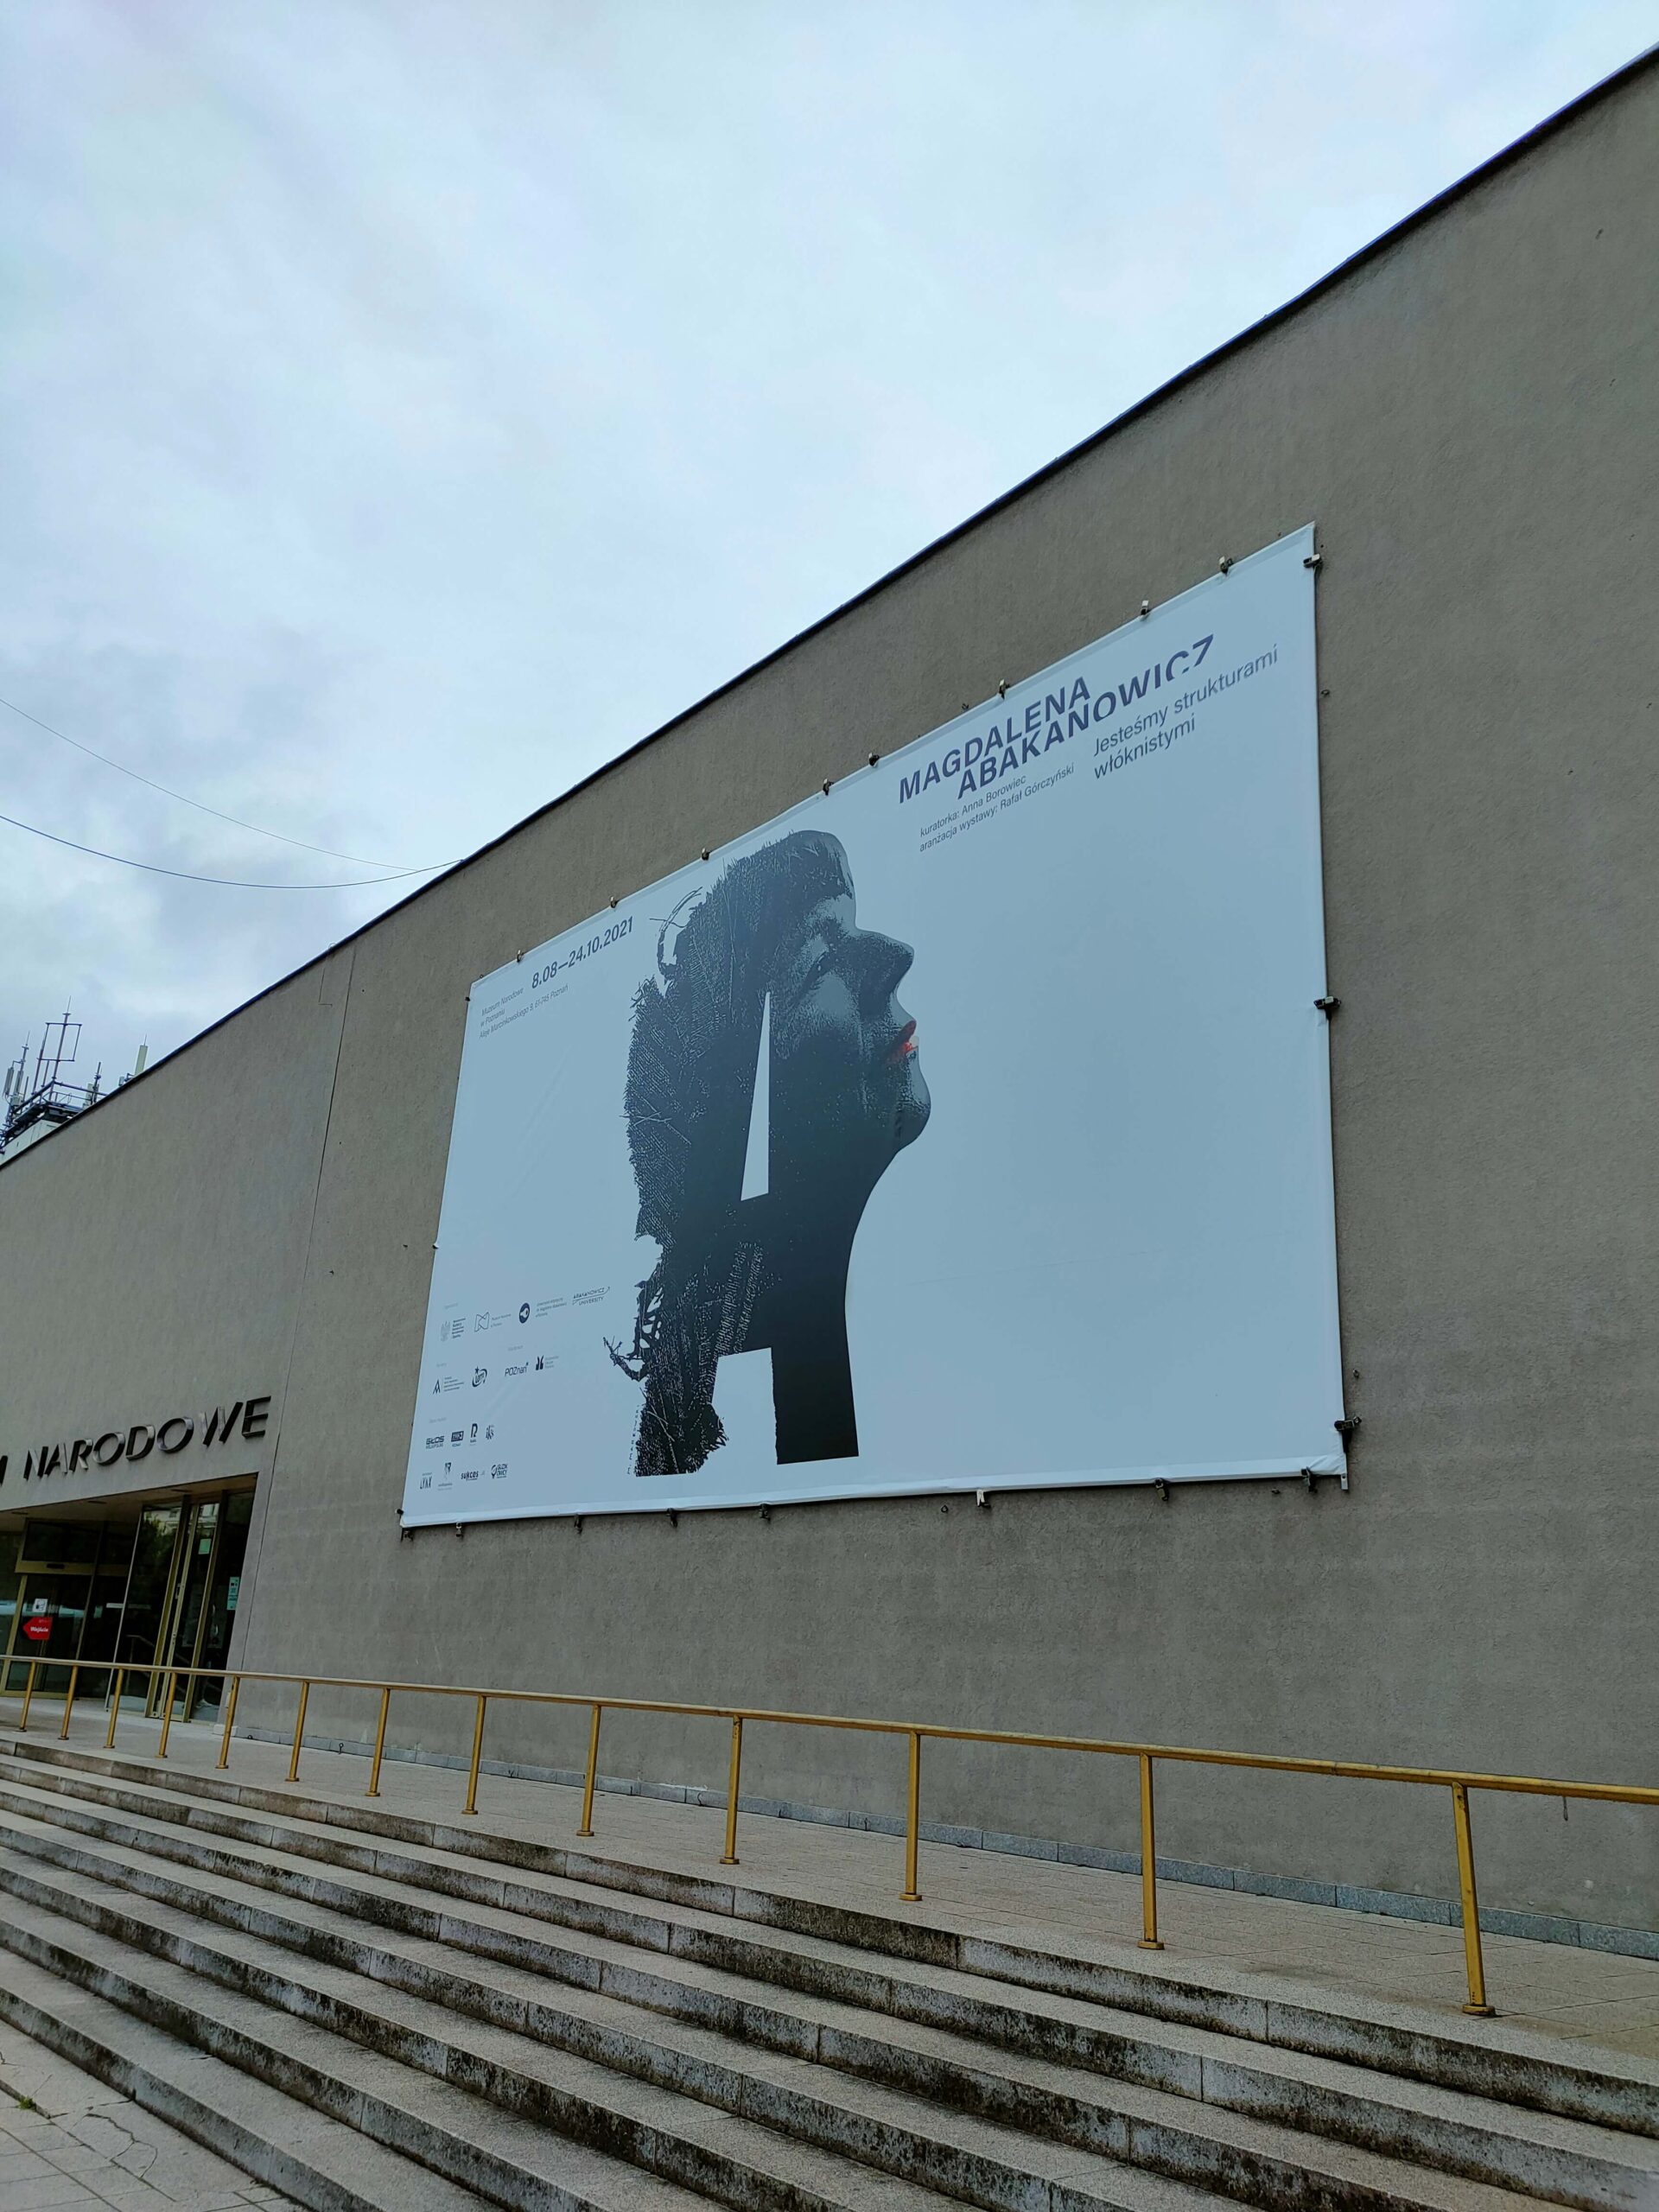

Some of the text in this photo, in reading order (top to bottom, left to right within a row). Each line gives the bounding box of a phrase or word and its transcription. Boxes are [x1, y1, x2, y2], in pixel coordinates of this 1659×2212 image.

[899, 677, 1090, 804] MAGDALENA
[957, 634, 1213, 800] ABAKANOWICZ
[1094, 644, 1278, 757] Jesteśmy strukturami
[1095, 713, 1196, 779] włóknistymi
[919, 762, 1075, 853] aranżacja wystawy: Rafał Górczyński
[920, 775, 1027, 838] kuratorka: Anna Borowiec
[23, 1395, 271, 1481] NARODOWE
